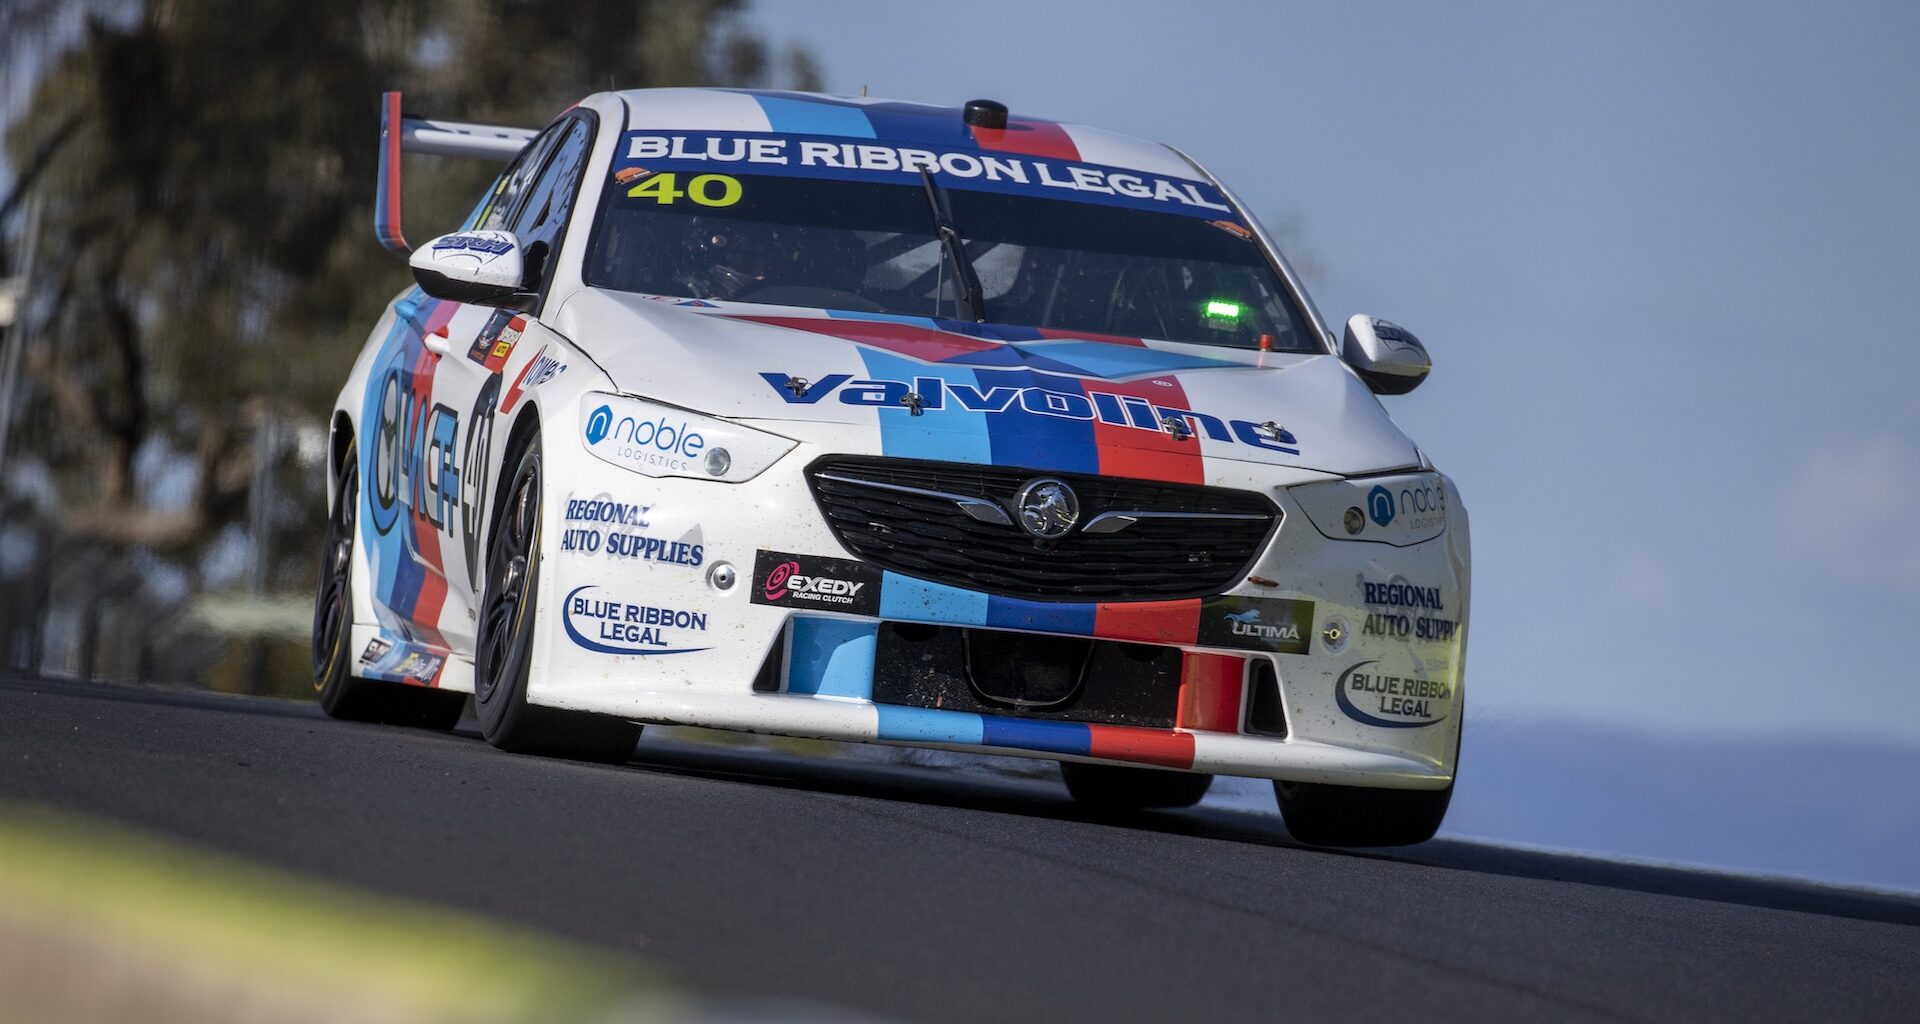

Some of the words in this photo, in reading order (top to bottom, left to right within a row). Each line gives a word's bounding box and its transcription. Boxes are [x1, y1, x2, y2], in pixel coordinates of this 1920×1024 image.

[626, 136, 788, 165] BLUE
[799, 141, 1030, 184] RIBBON
[1032, 162, 1231, 213] LEGAL
[627, 172, 743, 208] 40
[758, 372, 1300, 456] Valvoline
[614, 417, 704, 458] noble
[617, 446, 688, 472] LOGISTICS
[565, 499, 650, 528] REGIONAL
[560, 529, 601, 551] AUTO
[606, 532, 704, 567] SUPPLIES
[786, 574, 864, 596] EXEDY
[792, 591, 822, 601] RACING
[822, 594, 854, 605] CLUTCH
[1364, 582, 1443, 610] REGIONAL
[573, 597, 621, 621] BLUE
[624, 604, 707, 631] RIBBON
[1362, 614, 1410, 637] AUTO
[600, 621, 668, 647] LEGAL
[1232, 621, 1300, 640] ULTIMA
[1351, 673, 1400, 696] BLUE
[1380, 696, 1432, 718] LEGAL
